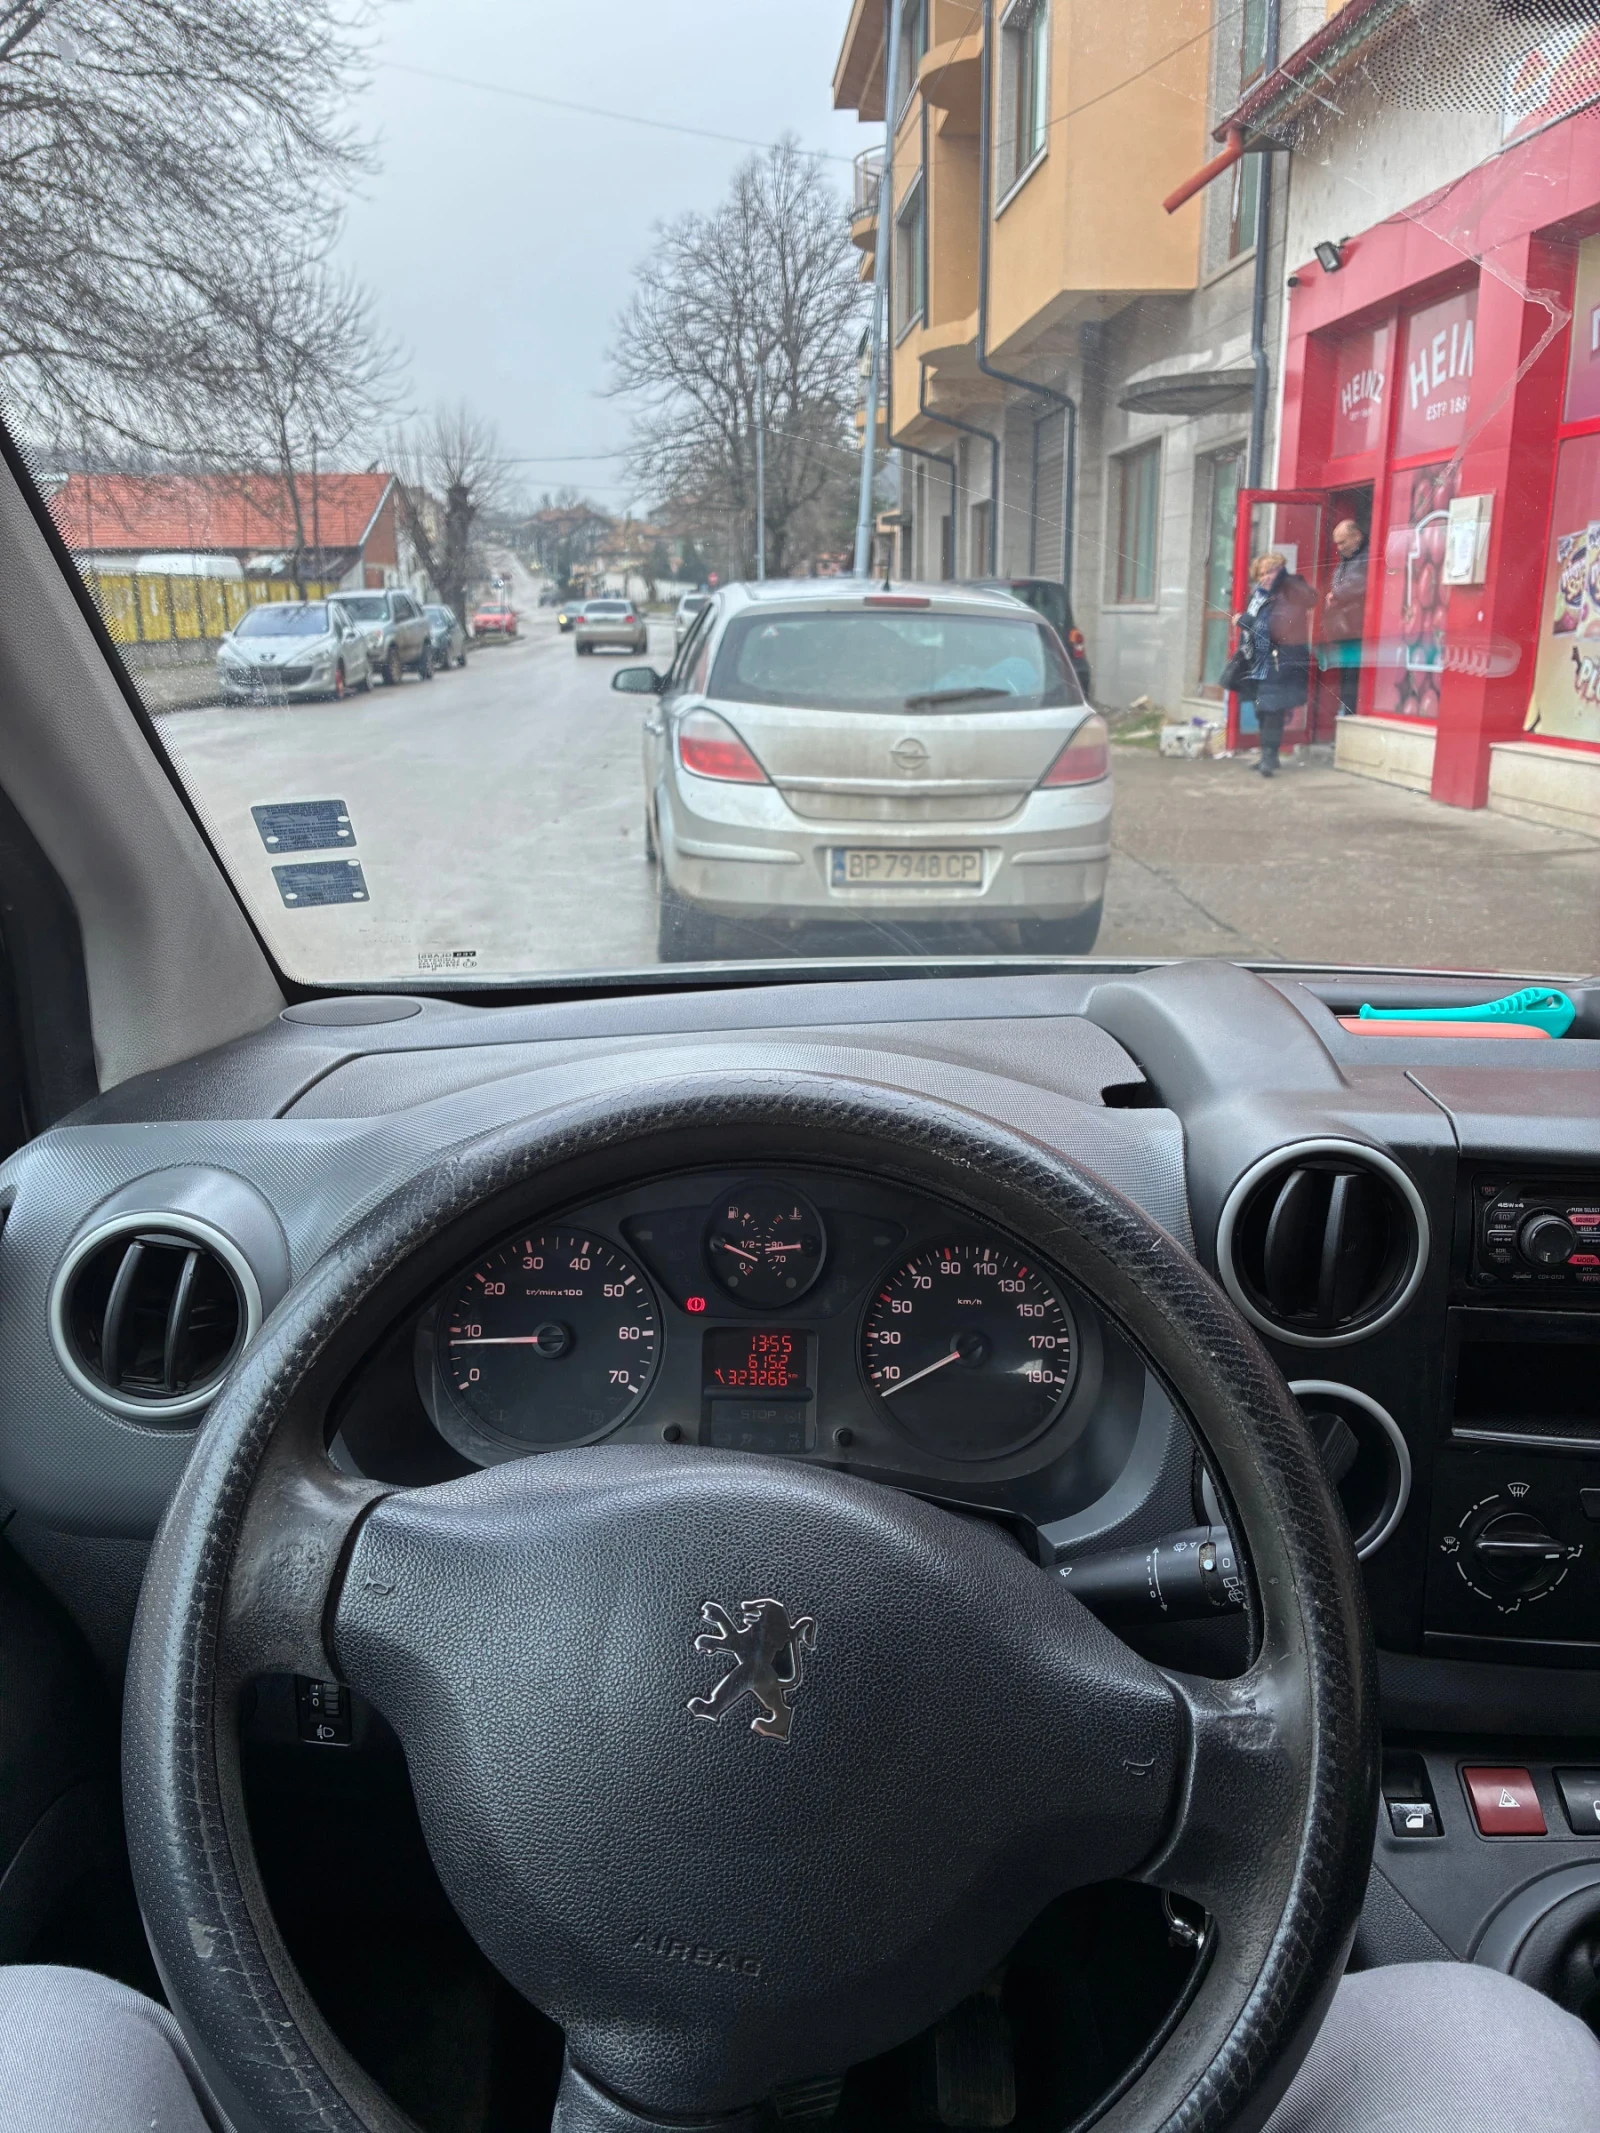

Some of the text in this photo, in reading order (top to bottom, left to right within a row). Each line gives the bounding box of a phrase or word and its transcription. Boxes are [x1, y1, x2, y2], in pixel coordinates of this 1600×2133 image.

[1341, 369, 1385, 415] HEINZ
[884, 854, 941, 878] 7948
[946, 854, 977, 878] CP
[522, 1257, 544, 1270] 30
[569, 1257, 590, 1270] 40
[940, 1262, 961, 1275] 90
[973, 1262, 997, 1275] 110
[484, 1282, 505, 1295] 20
[912, 1276, 932, 1289] 70
[998, 1280, 1026, 1292] 130
[603, 1284, 624, 1297] 50
[891, 1301, 912, 1313] 50
[1017, 1304, 1044, 1317] 150
[464, 1324, 482, 1337] 10
[618, 1327, 640, 1340] 60
[752, 1335, 792, 1352] 13:55
[880, 1331, 901, 1344] 30
[1028, 1336, 1055, 1349] 170
[469, 1368, 480, 1381] 0
[609, 1370, 629, 1383] 70
[728, 1370, 788, 1386] 323266
[882, 1366, 900, 1379] 10
[1025, 1370, 1053, 1383] 190
[741, 1410, 777, 1419] STOP
[633, 1933, 762, 1977] AIRBAG
